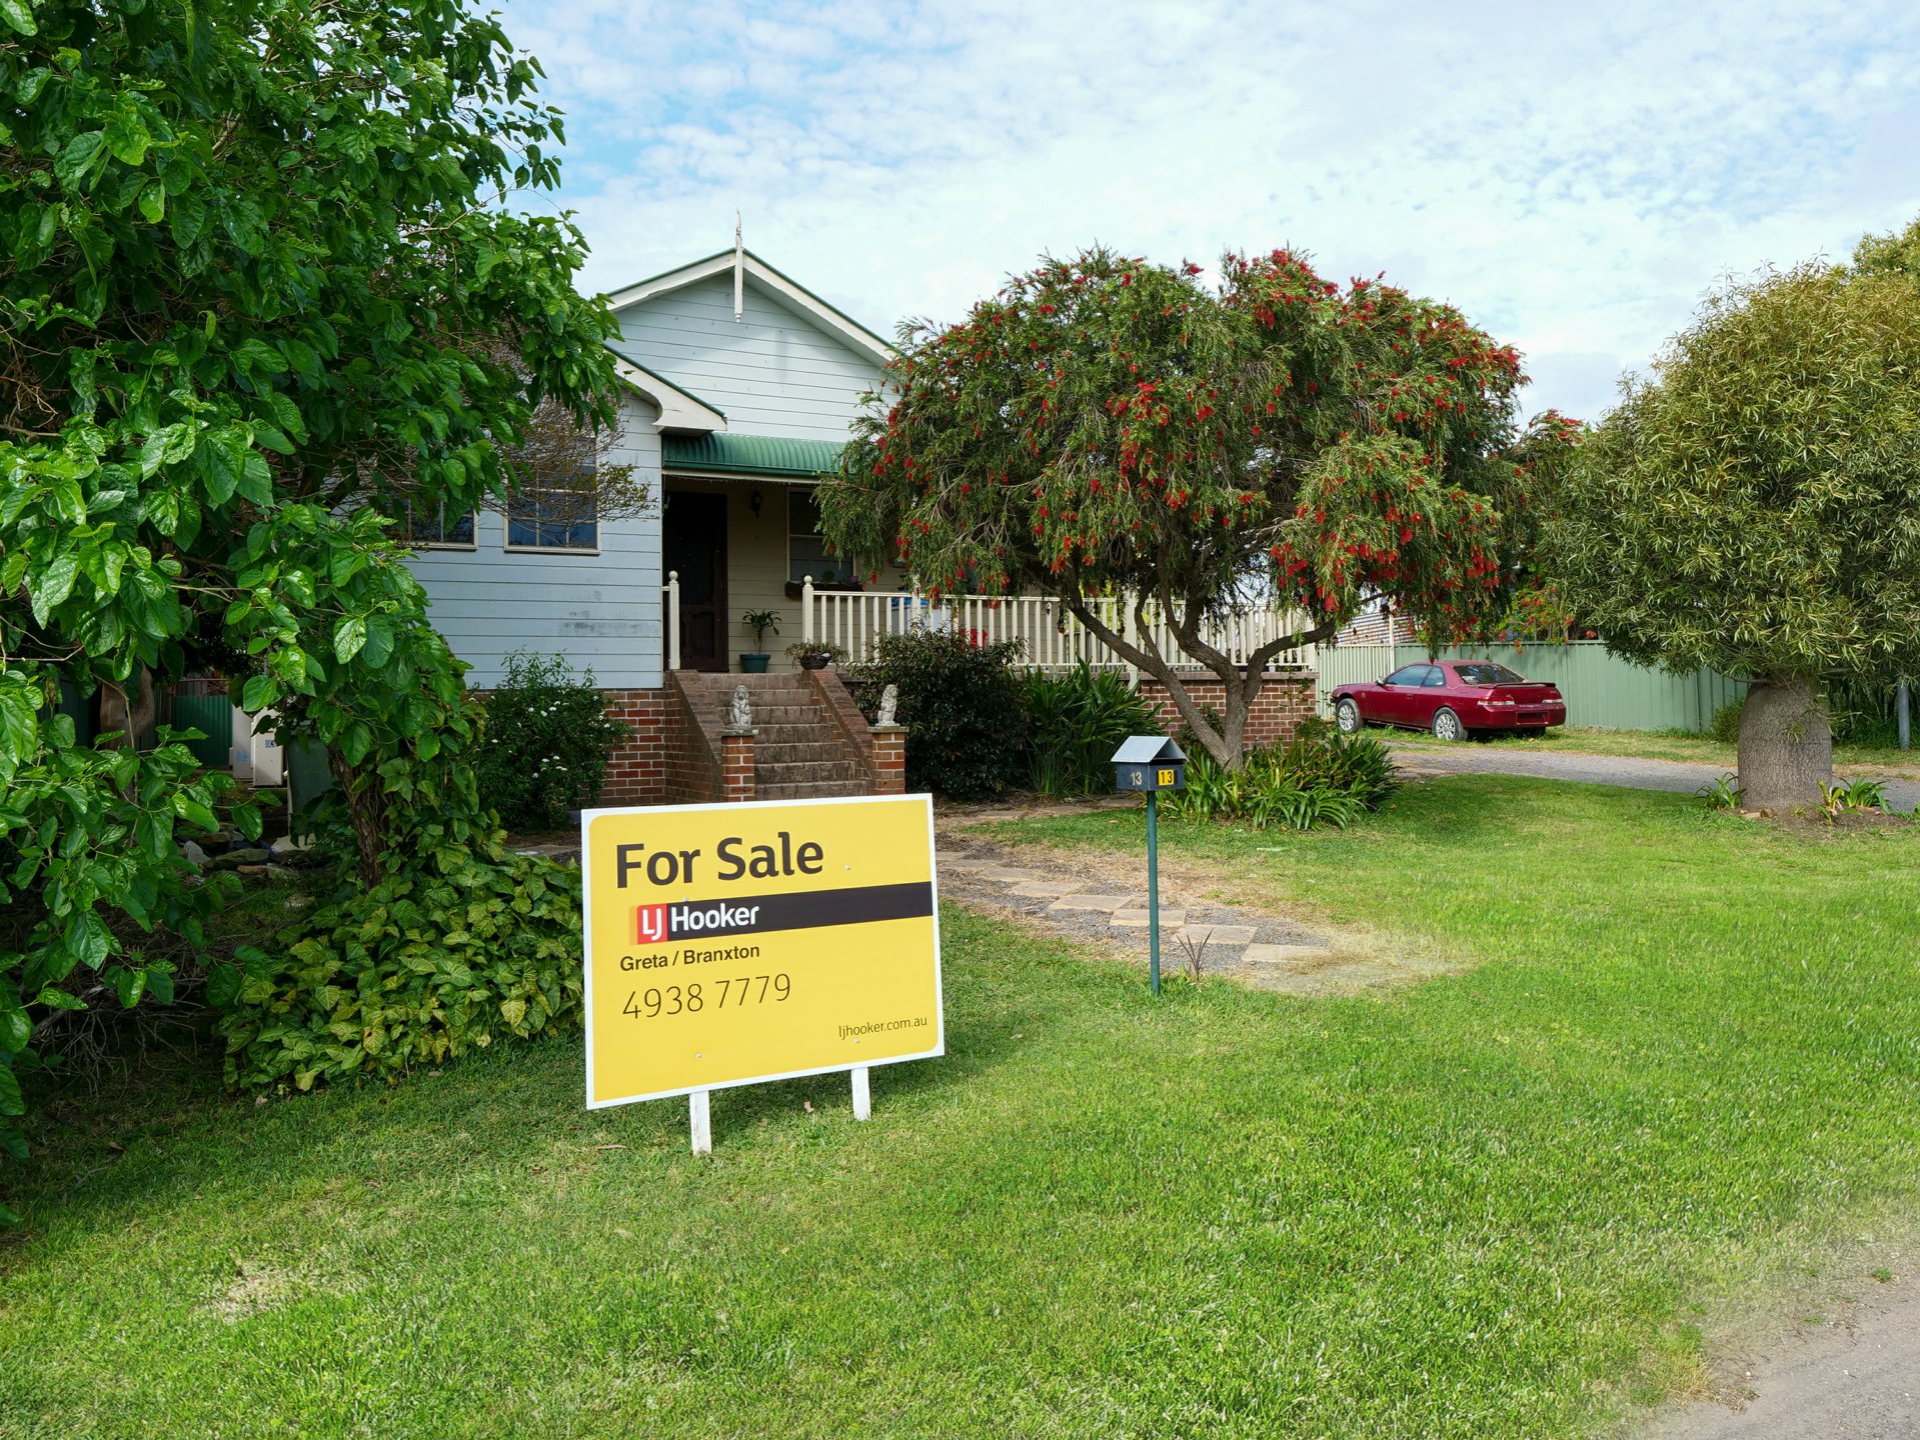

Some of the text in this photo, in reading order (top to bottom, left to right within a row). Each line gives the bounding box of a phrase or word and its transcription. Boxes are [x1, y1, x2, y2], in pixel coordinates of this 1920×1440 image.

[1130, 771, 1143, 786] 13
[1160, 771, 1173, 784] 13
[616, 831, 824, 888] For Sale
[641, 903, 760, 940] LJ Hooker
[619, 955, 669, 972] Greta
[683, 945, 761, 965] Branxton
[622, 973, 791, 1019] 4938 7779
[838, 1016, 928, 1040] ljhooker.com.au
